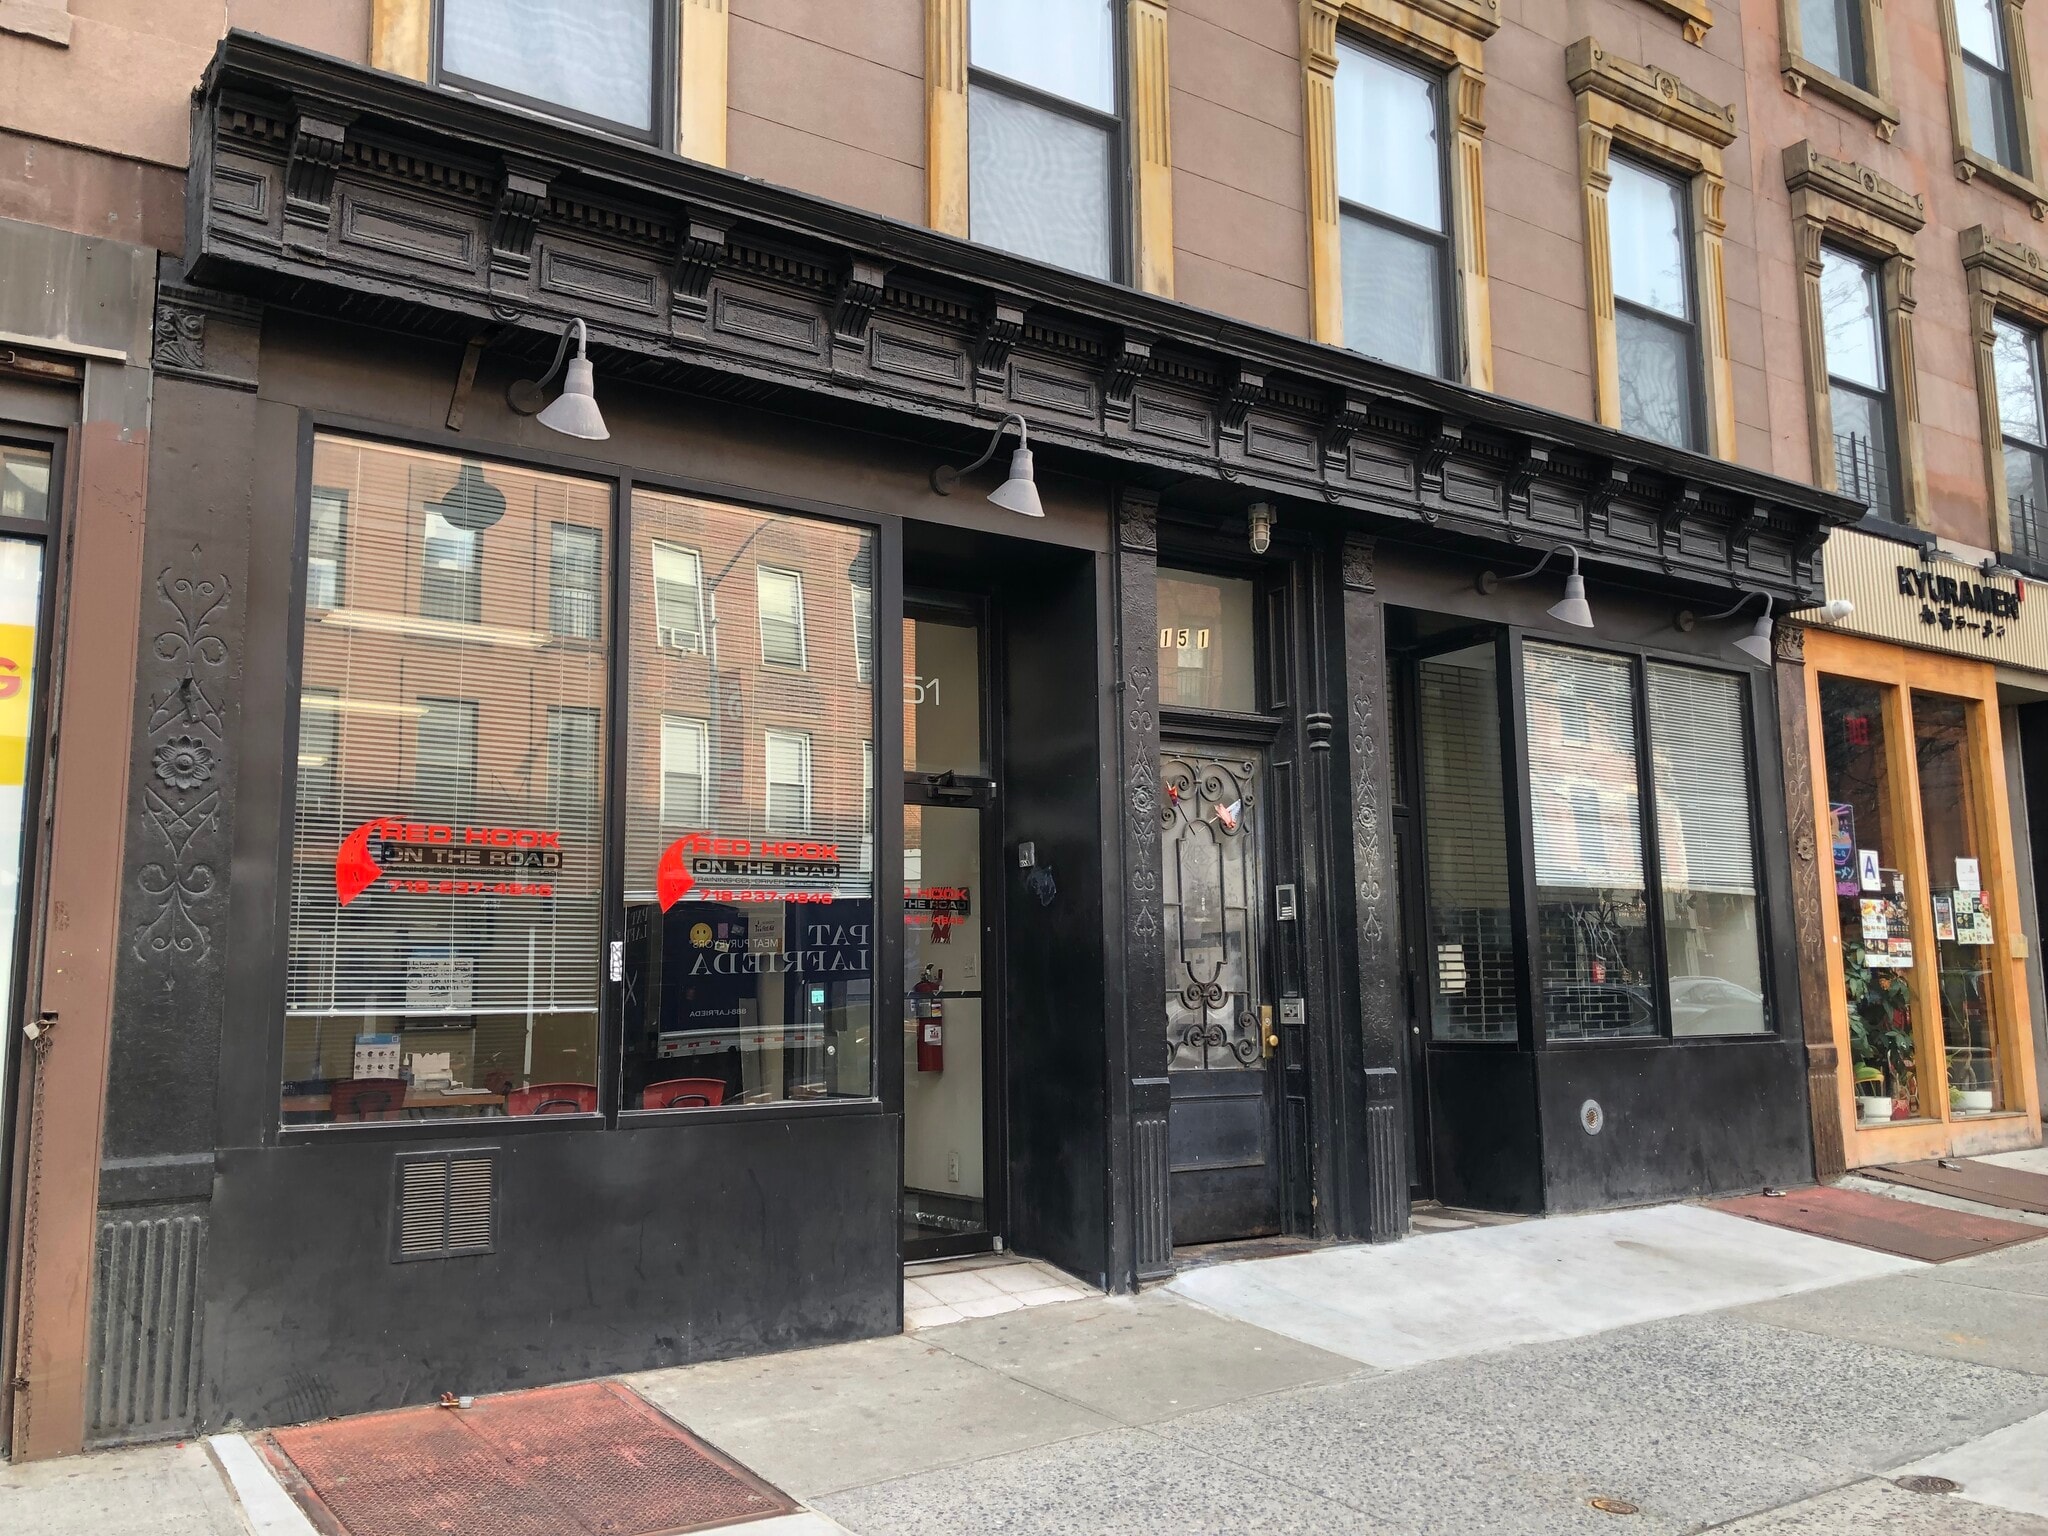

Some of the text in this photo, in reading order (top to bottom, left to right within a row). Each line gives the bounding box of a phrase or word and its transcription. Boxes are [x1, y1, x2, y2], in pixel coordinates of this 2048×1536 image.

[1897, 565, 2019, 619] KYURAMEN
[1164, 630, 1205, 647] 151
[903, 676, 940, 706] 51
[380, 823, 561, 849] RED HOOK
[385, 847, 559, 867] ON THE ROAD
[692, 838, 840, 861] RED HOOK
[695, 859, 837, 878] ON THE ROAD
[1864, 855, 1876, 879] A
[388, 880, 553, 896] 718-237-4846
[699, 889, 833, 904] 718-237-4846
[917, 887, 968, 900] HOOK
[904, 899, 925, 909] THE
